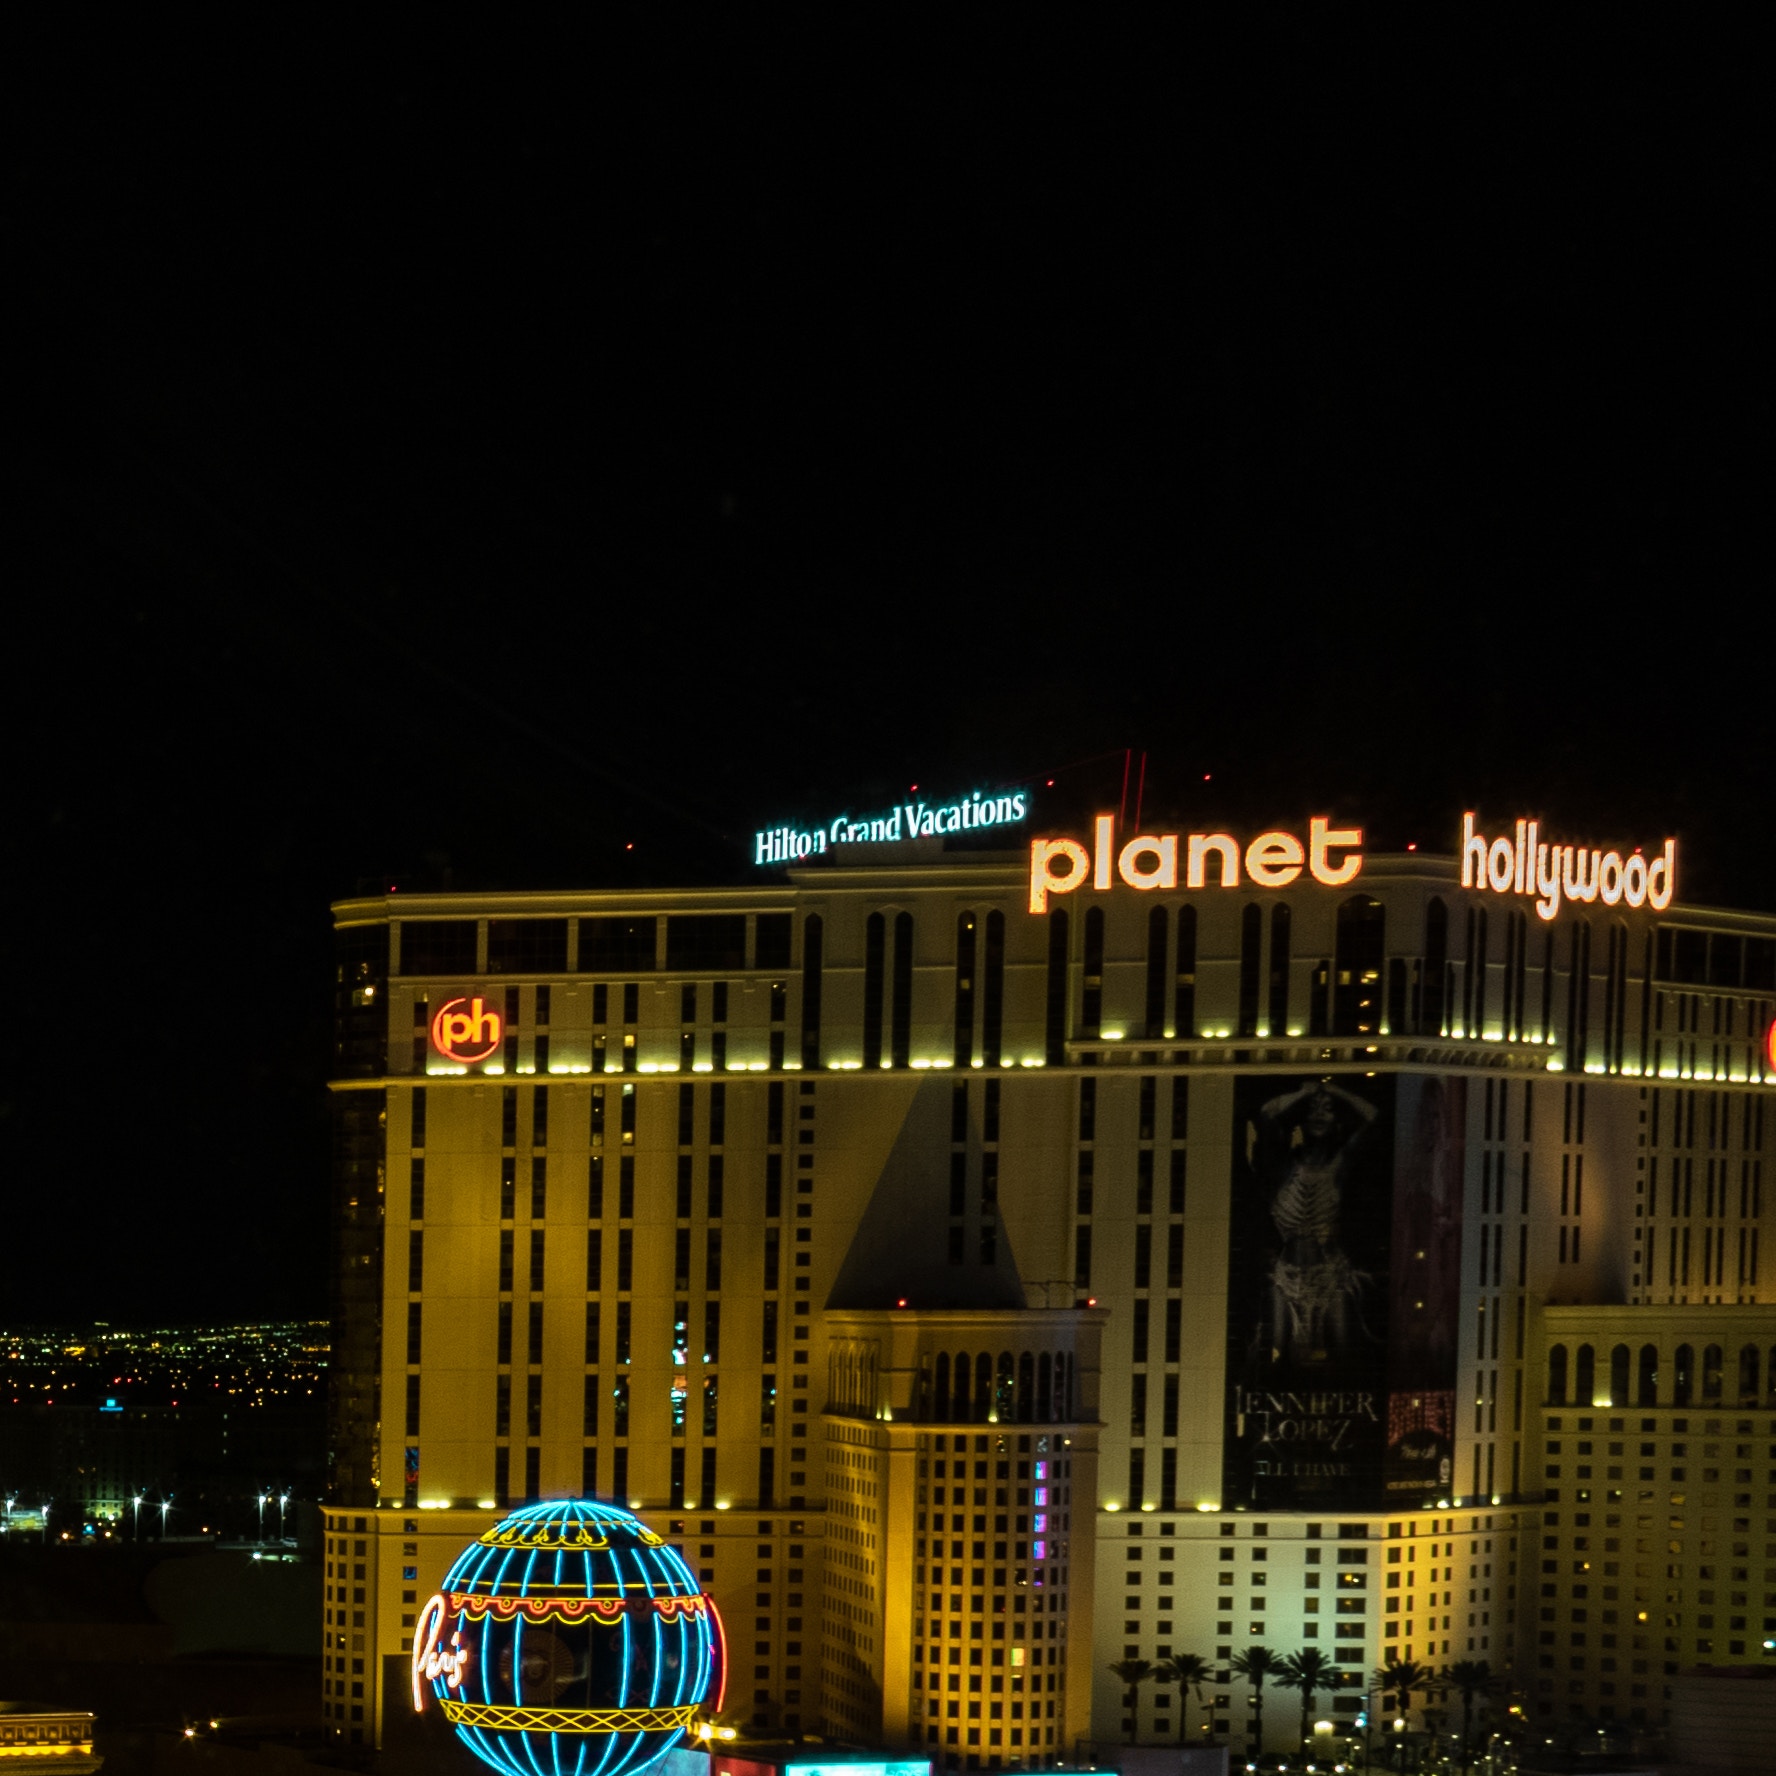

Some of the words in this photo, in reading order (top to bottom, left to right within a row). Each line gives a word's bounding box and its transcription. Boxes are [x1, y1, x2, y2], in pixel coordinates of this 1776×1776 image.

[755, 827, 826, 865] Hilton
[830, 806, 901, 843] Grand
[905, 791, 1026, 838] Vacations
[1029, 812, 1363, 914] planet
[1461, 811, 1676, 920] hollywood
[442, 998, 501, 1051] ph
[1235, 1385, 1379, 1421] JENNIFER
[1256, 1411, 1354, 1451] LOPEZ
